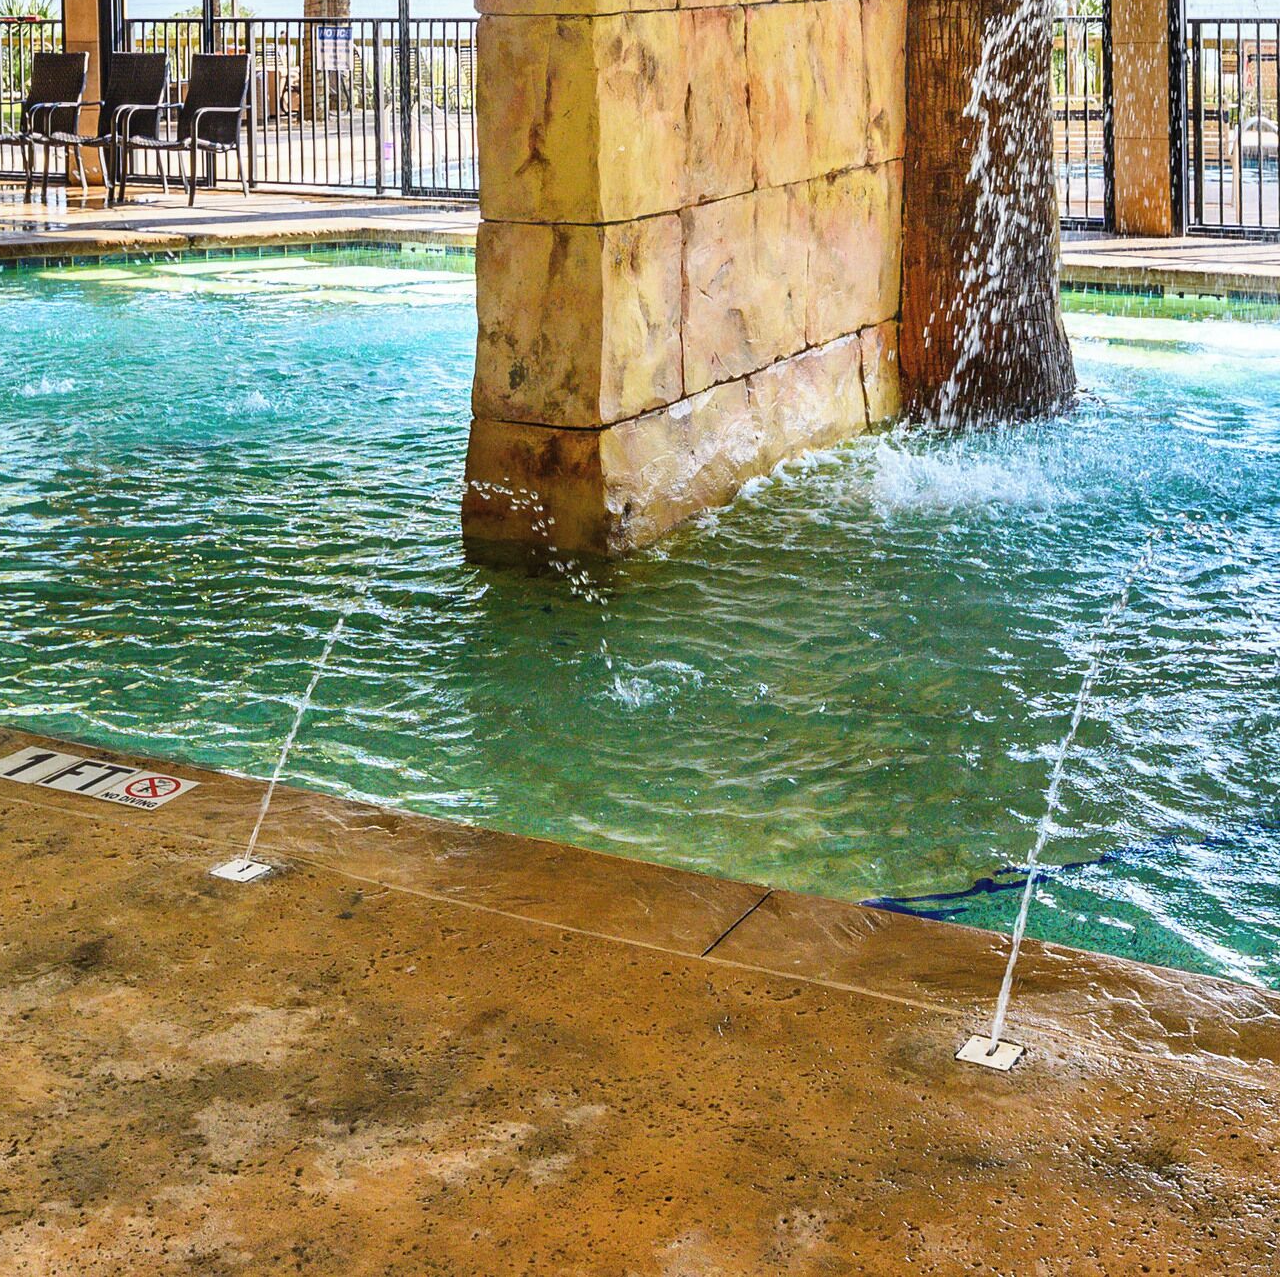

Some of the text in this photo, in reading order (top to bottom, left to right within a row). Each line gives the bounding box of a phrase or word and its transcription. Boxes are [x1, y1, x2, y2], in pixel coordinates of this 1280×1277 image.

[3, 753, 136, 792] 1 FT
[101, 791, 158, 808] NO DIVING
